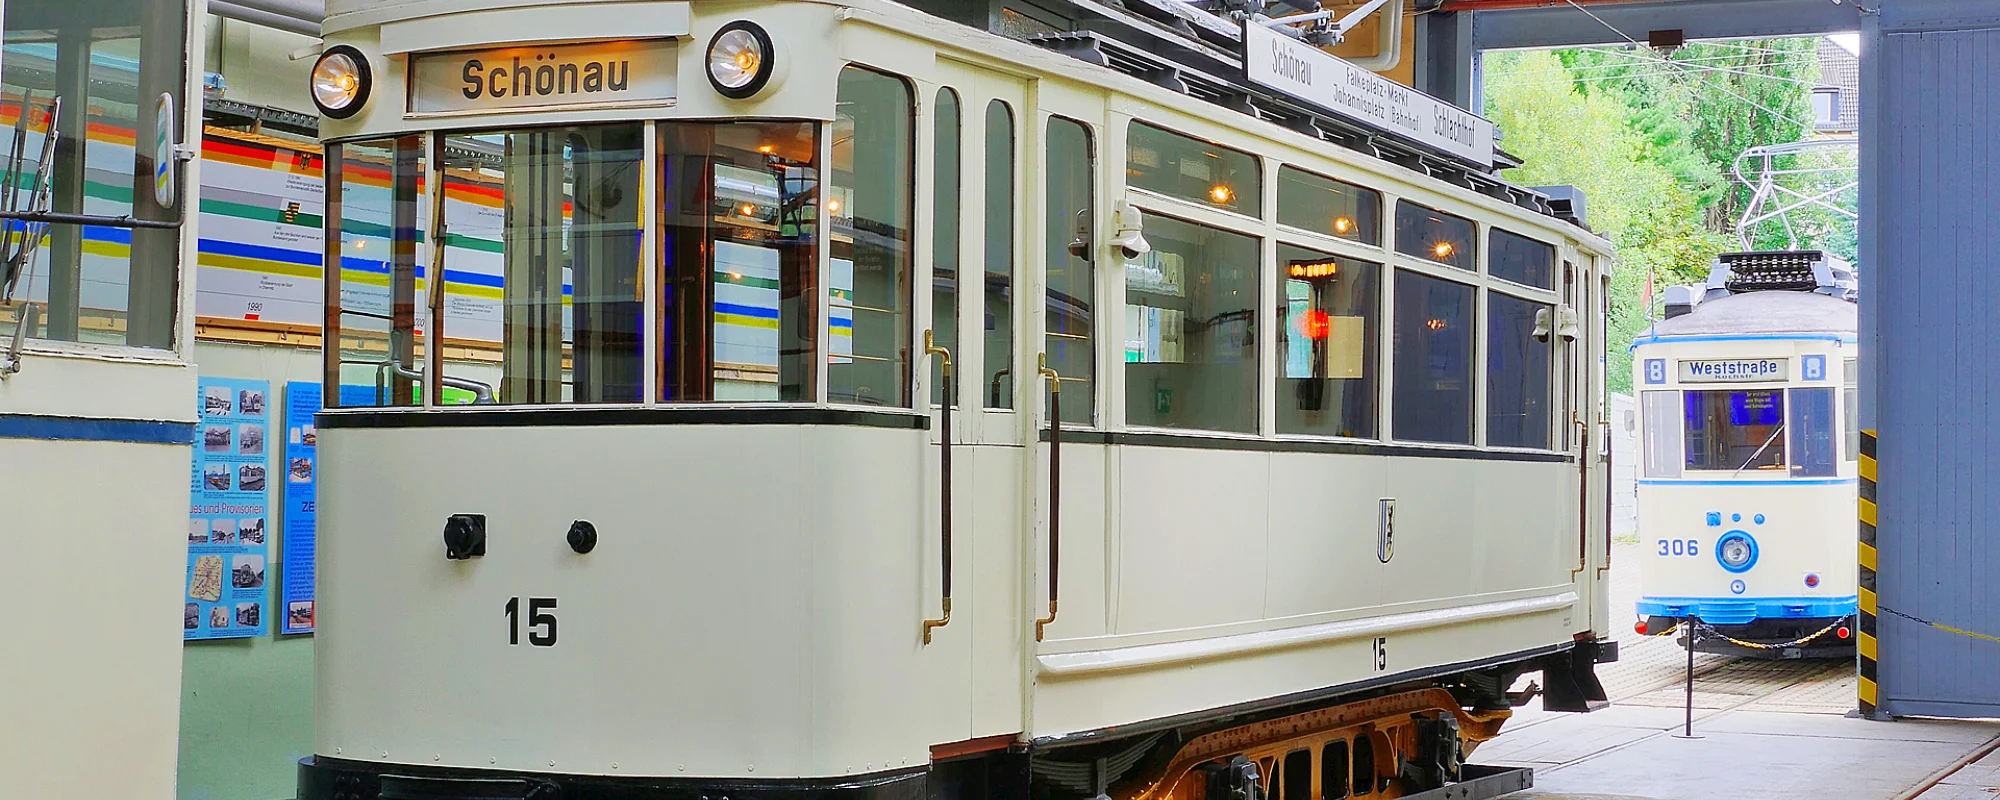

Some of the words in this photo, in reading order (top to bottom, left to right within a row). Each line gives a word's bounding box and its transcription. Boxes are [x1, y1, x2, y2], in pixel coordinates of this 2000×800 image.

[1272, 38, 1312, 86] Schönau
[462, 53, 629, 99] Schönau
[1333, 83, 1386, 119] Johannisplatz
[1391, 105, 1419, 132] Bahnhof
[1433, 104, 1475, 148] Schlachthof
[247, 302, 263, 311] 1990
[1650, 361, 1662, 381] 8
[1690, 360, 1777, 375] Weststraße
[1806, 357, 1821, 378] 8
[204, 503, 220, 514] und
[222, 502, 264, 514] Provisorien
[1658, 539, 1698, 556] 306
[505, 597, 557, 646] 15
[1373, 638, 1386, 671] 15
